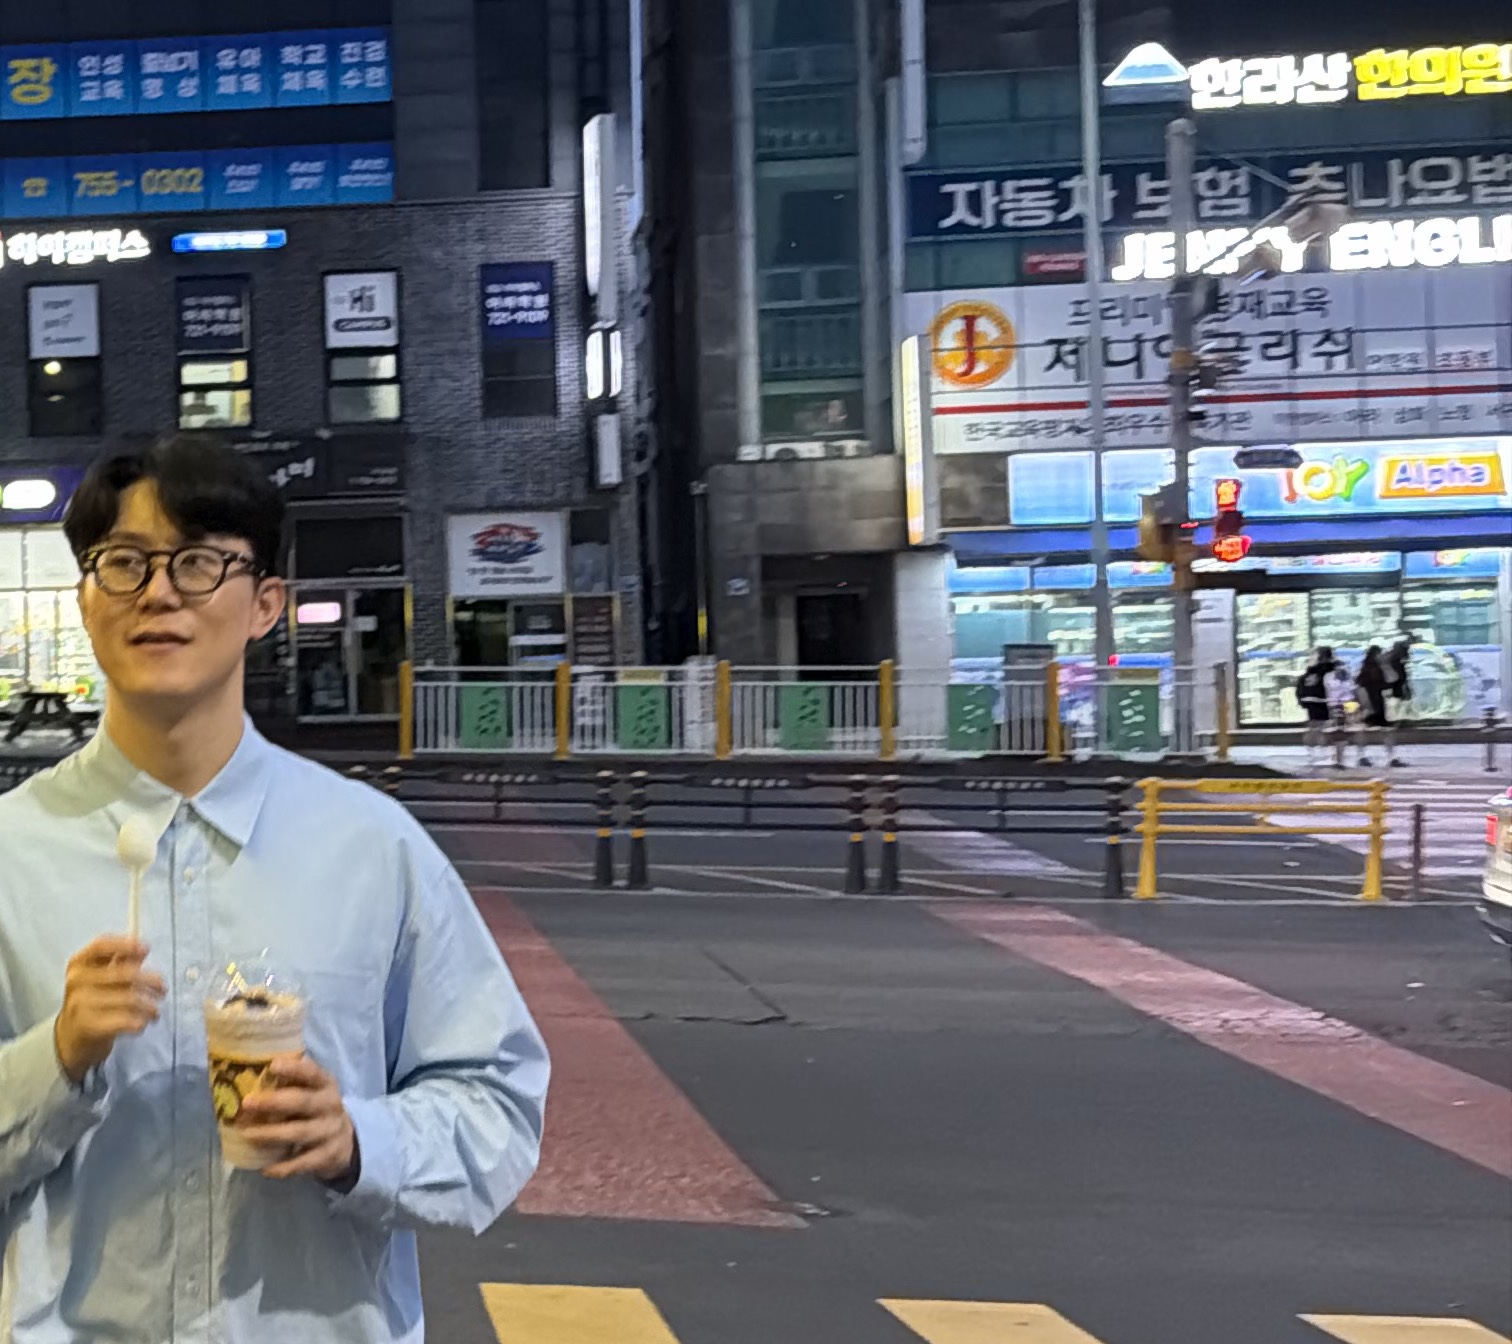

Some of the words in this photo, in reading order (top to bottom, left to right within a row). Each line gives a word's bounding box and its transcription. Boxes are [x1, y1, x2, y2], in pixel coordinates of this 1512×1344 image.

[1187, 52, 1352, 111] 한라산
[937, 173, 1118, 230] 자동차
[1393, 460, 1491, 491] Alpha
